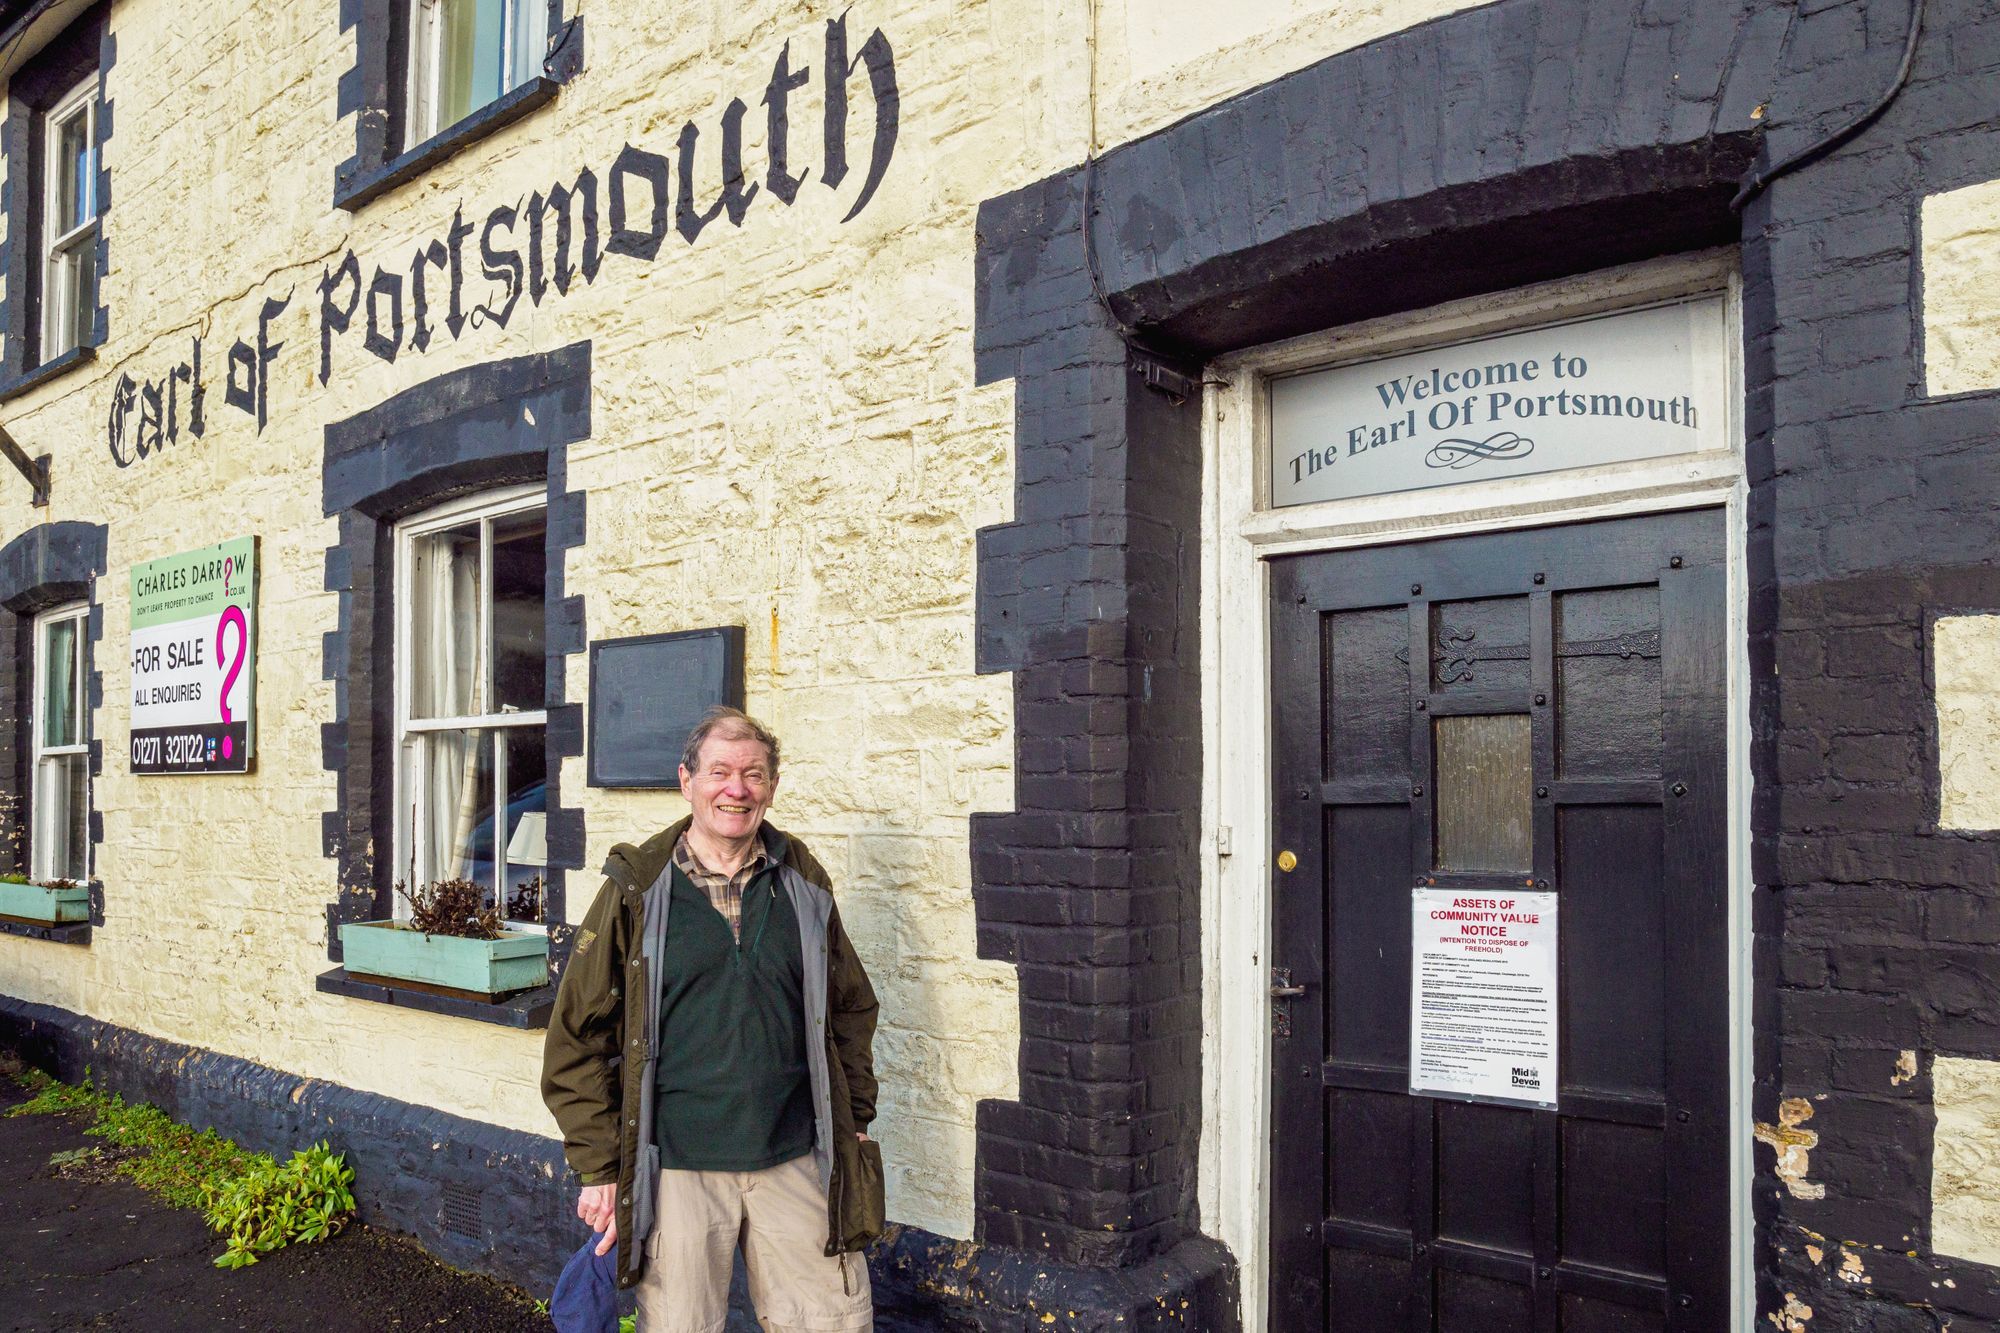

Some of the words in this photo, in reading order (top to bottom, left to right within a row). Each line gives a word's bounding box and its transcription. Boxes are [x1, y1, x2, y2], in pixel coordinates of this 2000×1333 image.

[108, 334, 207, 468] Earl
[226, 284, 296, 436] of
[316, 6, 900, 388] Portsmouth
[1375, 355, 1540, 410] Welcome
[1551, 351, 1588, 379] to
[1289, 444, 1338, 485] The
[1346, 411, 1416, 458] Earl
[1428, 396, 1478, 431] Of
[1486, 388, 1700, 430] Portsmouth
[137, 567, 186, 598] CHARLES
[136, 605, 150, 616] DON'T
[150, 602, 163, 613] LEAVE
[164, 598, 187, 610] PROPERTY
[187, 596, 194, 606] TO
[195, 591, 214, 605] CHANCE
[135, 645, 161, 674] FOR
[167, 638, 204, 670] SALE
[134, 687, 149, 707] ALL
[152, 682, 202, 705] ENQUIRIES
[132, 736, 161, 765] 01271
[165, 733, 204, 764] 321122
[1452, 898, 1497, 909] ASSETS
[1499, 899, 1515, 909] OF
[1430, 910, 1498, 923] COMMUNITY
[1500, 912, 1540, 924] VALUE
[1439, 936, 1476, 945] (INTENTION
[1488, 939, 1518, 947] DISPOSE
[1460, 924, 1507, 937] NOTICE
[1464, 945, 1503, 954] FREEHOLD)
[1511, 1067, 1529, 1077] Mid
[1511, 1075, 1541, 1087] Devon
